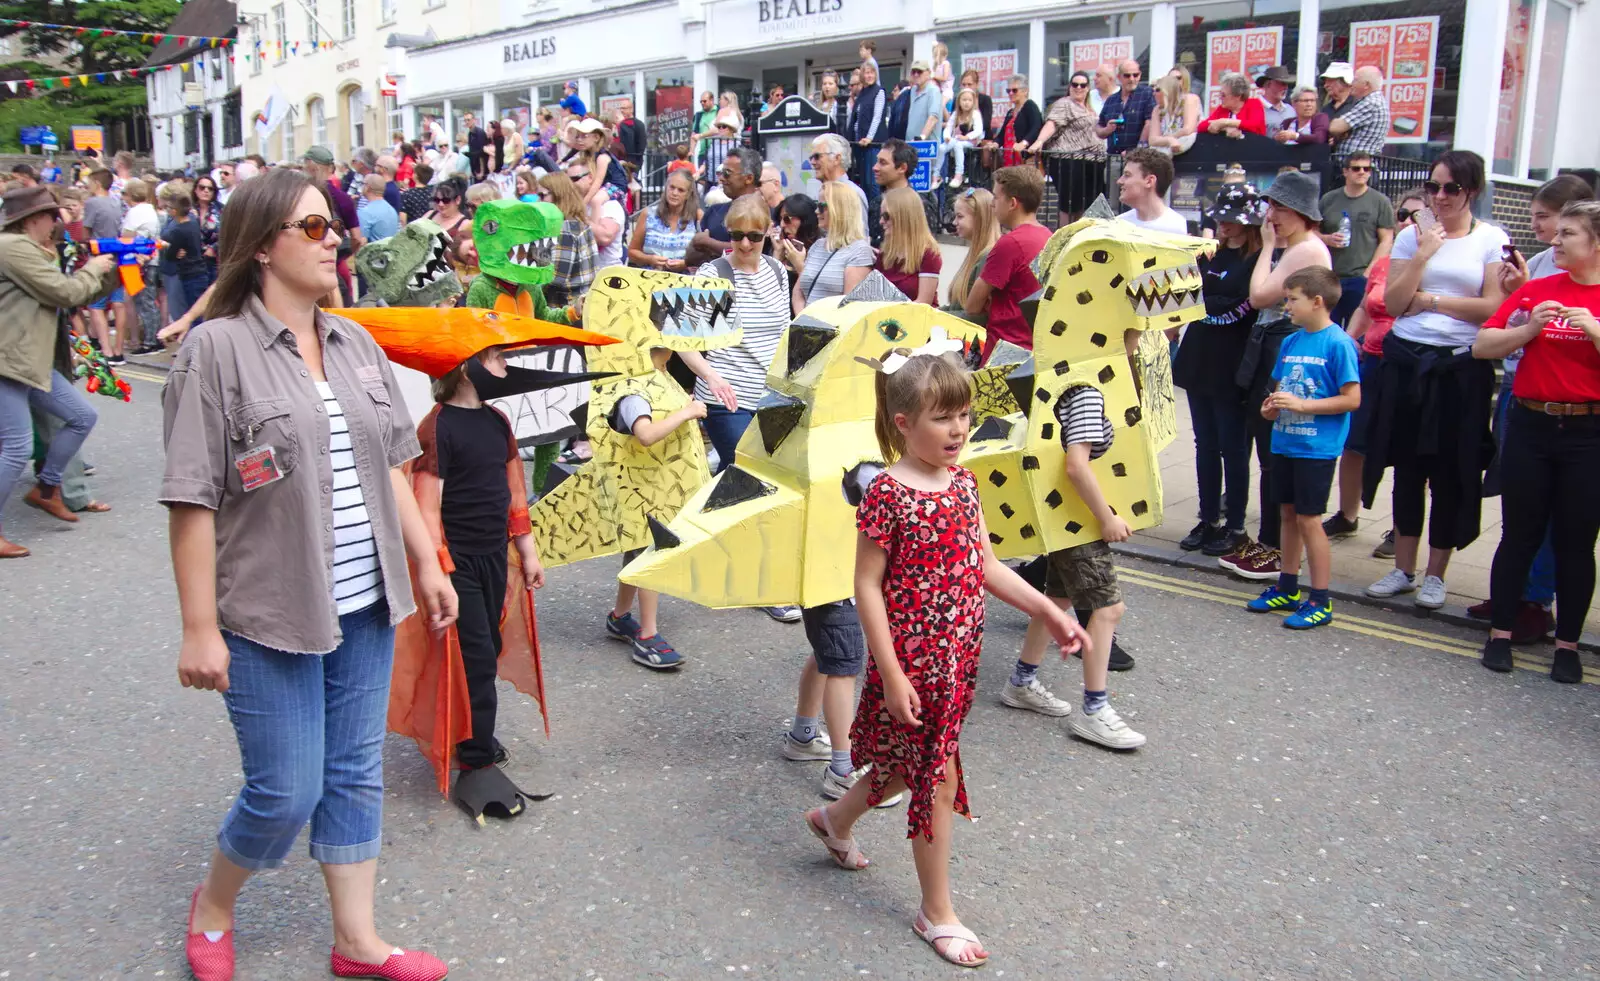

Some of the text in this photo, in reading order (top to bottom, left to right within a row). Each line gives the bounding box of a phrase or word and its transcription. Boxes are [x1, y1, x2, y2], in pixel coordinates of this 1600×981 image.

[757, 0, 844, 22] BEALES
[1246, 33, 1275, 52] 50%
[1356, 27, 1389, 47] 50%
[1396, 24, 1431, 44] 75%
[503, 36, 556, 63] BEALES
[1212, 36, 1241, 54] 50%
[991, 55, 1013, 71] 30%
[1391, 84, 1425, 103] 60%
[658, 128, 689, 148] SALE
